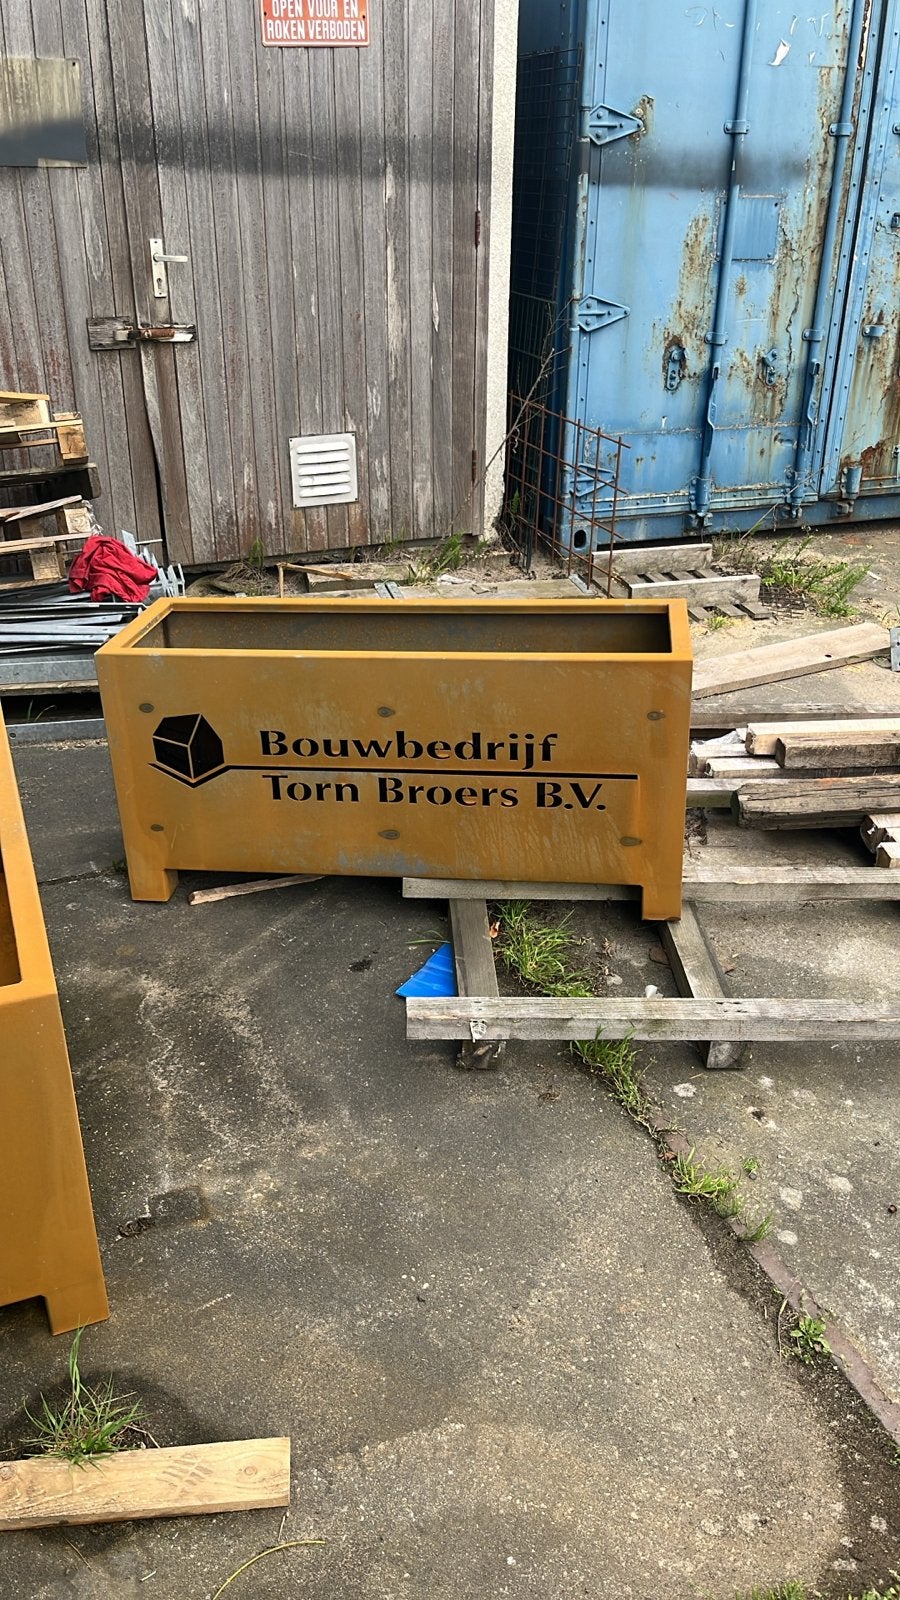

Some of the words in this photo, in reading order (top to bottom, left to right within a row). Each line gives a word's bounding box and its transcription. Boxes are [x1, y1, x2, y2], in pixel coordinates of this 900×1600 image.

[271, 0, 303, 18] OPEN
[307, 0, 338, 18] VUUR
[343, 0, 359, 18] EN
[266, 19, 306, 40] ROKEN
[307, 20, 366, 40] VERBODEN
[259, 730, 558, 770] Bouwbedrijf
[262, 776, 359, 802] Torn
[378, 778, 519, 807] Broers
[536, 783, 607, 811] B.V.
